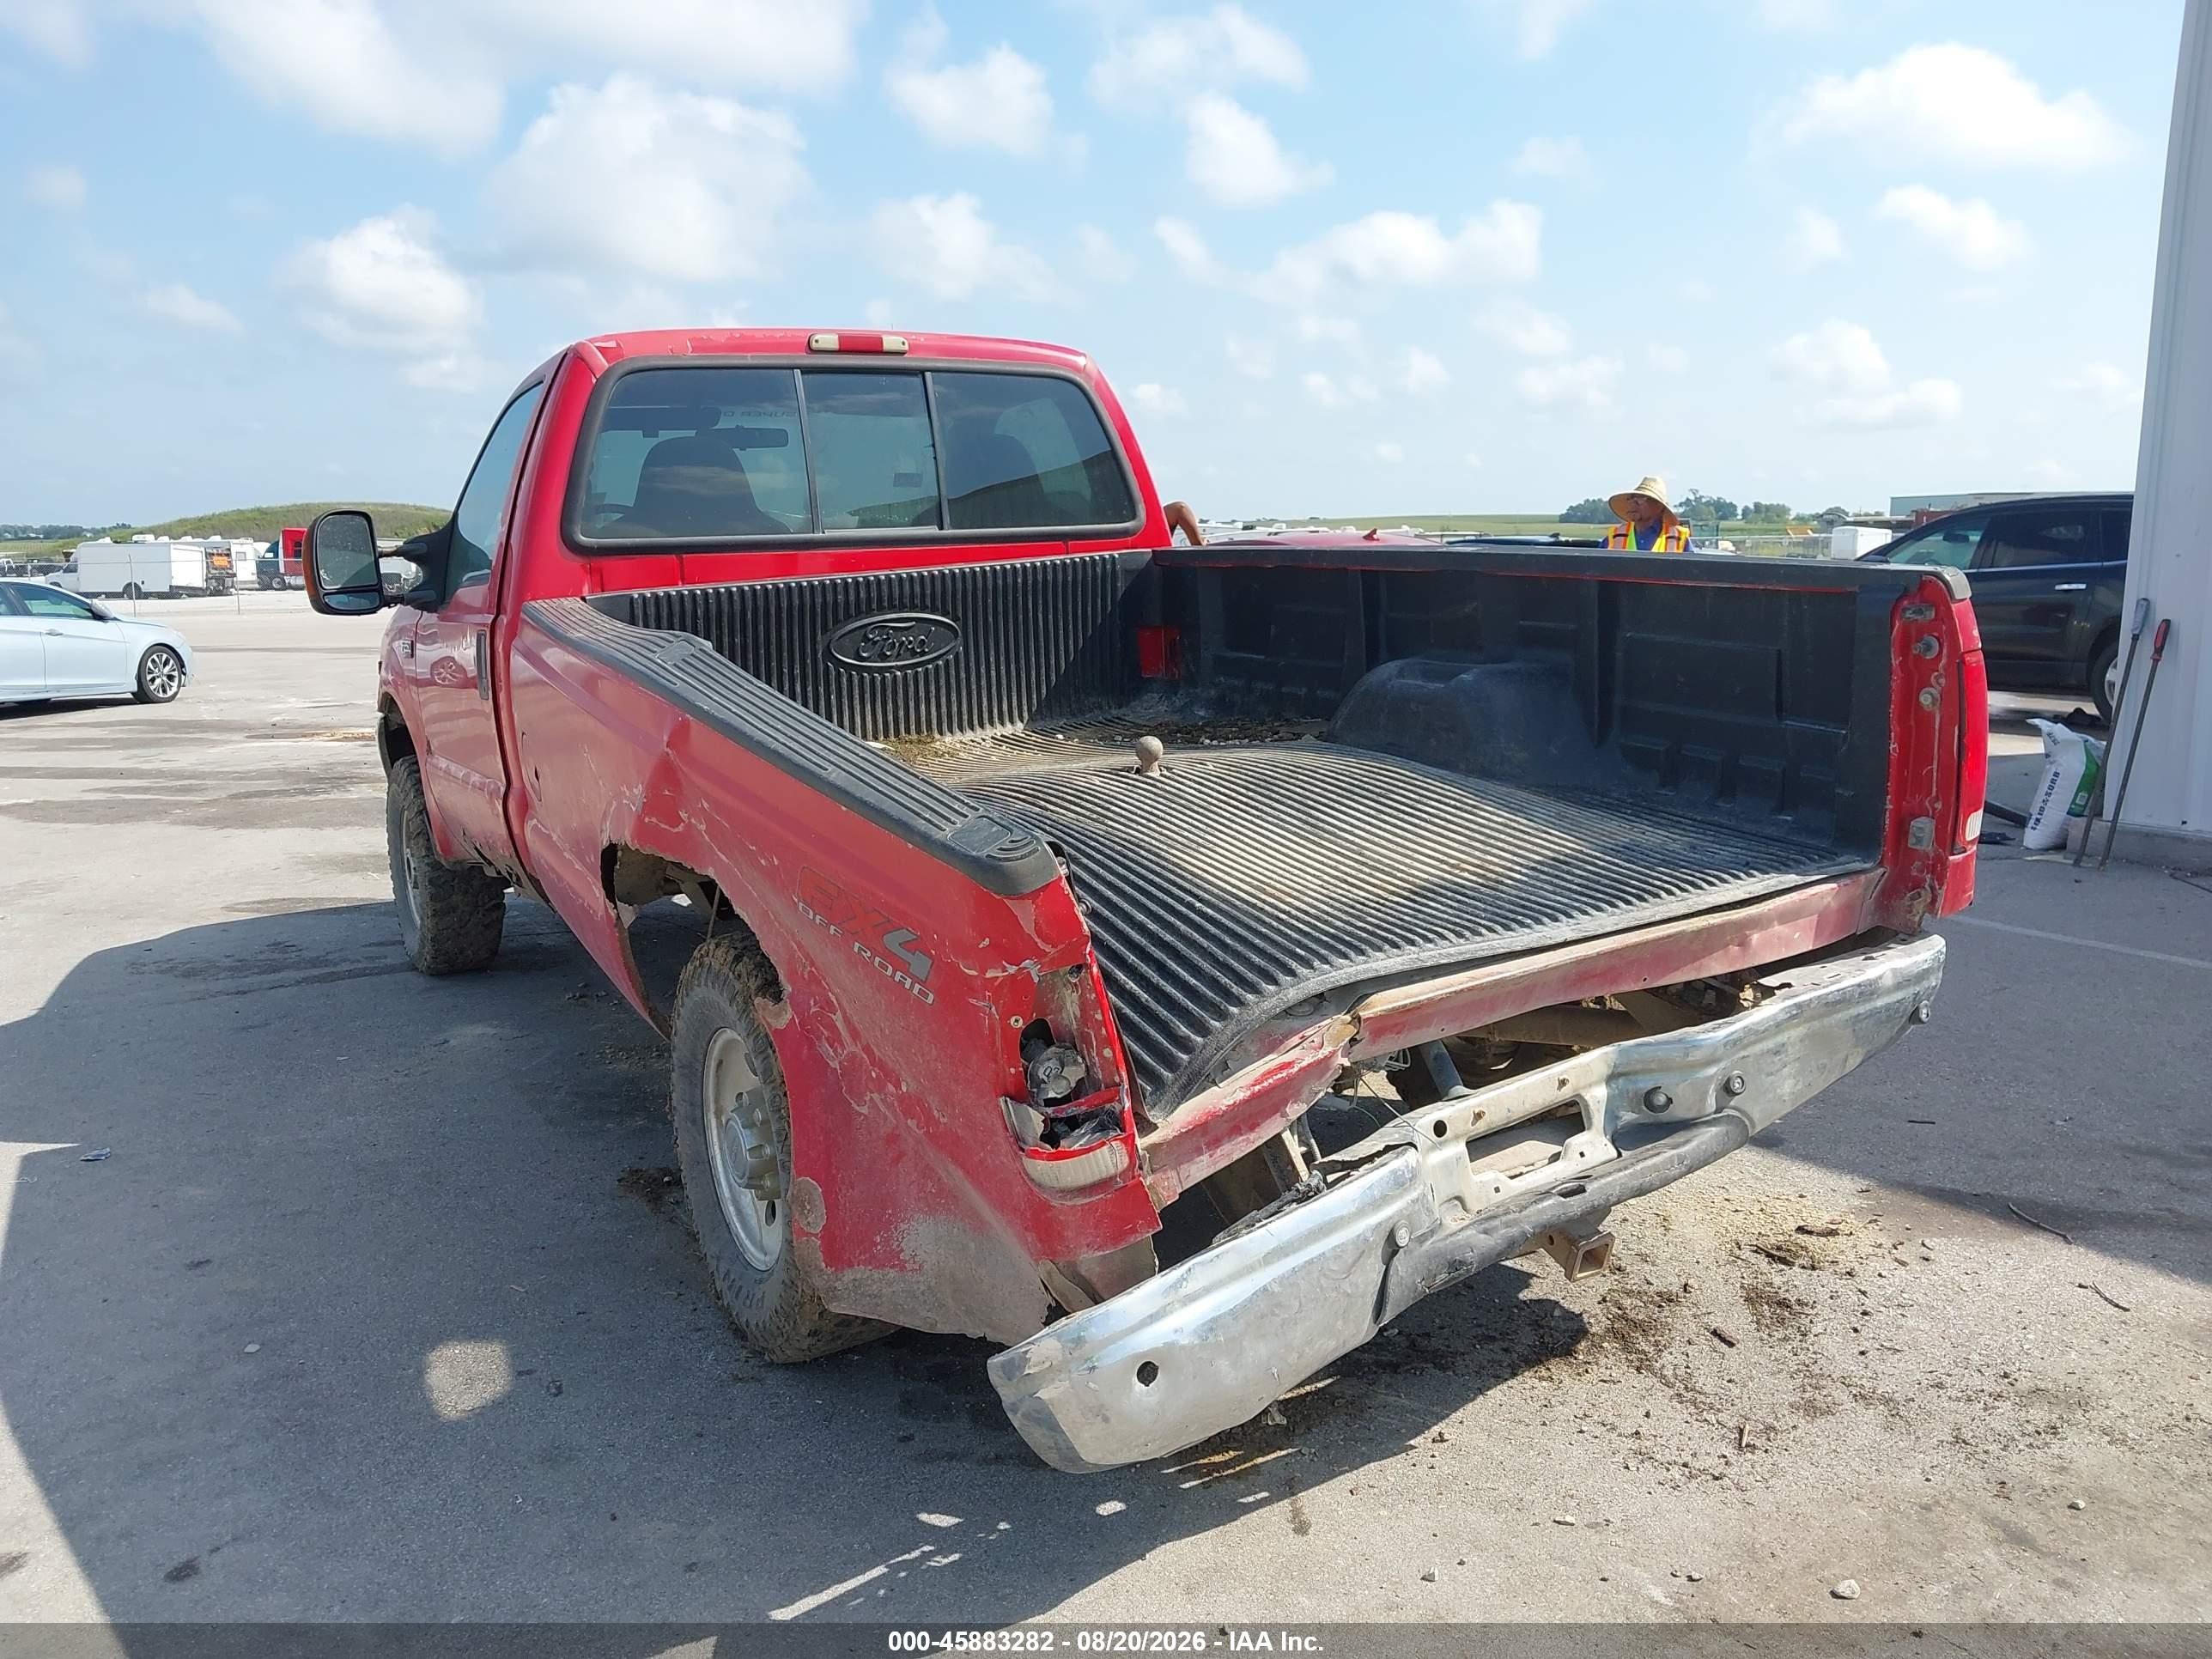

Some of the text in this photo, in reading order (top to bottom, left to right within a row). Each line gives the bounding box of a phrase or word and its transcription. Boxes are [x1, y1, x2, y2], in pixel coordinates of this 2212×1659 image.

[858, 621, 935, 661] Ford
[796, 866, 933, 982] FX4
[796, 901, 935, 1006] OFF ROAD
